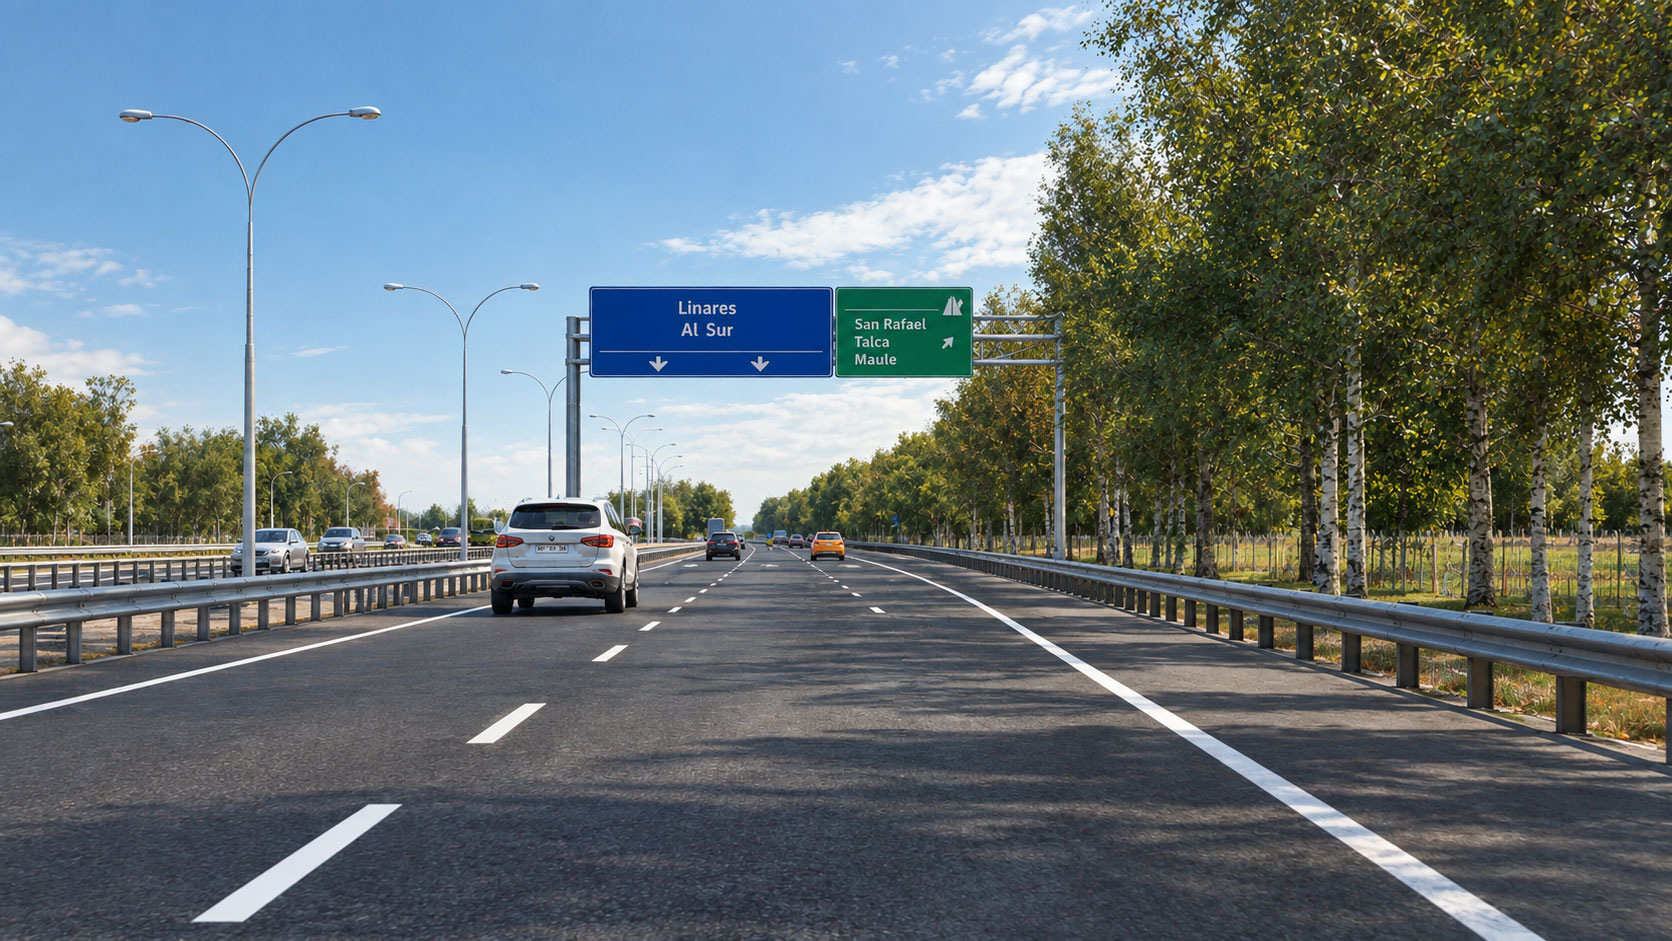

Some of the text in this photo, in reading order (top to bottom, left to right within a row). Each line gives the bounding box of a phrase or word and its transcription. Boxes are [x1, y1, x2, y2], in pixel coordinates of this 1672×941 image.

[678, 300, 737, 315] Linares
[681, 322, 734, 337] Al Sur
[854, 317, 927, 330] San Rafael
[854, 336, 890, 348] Talca
[854, 353, 897, 366] Maule
